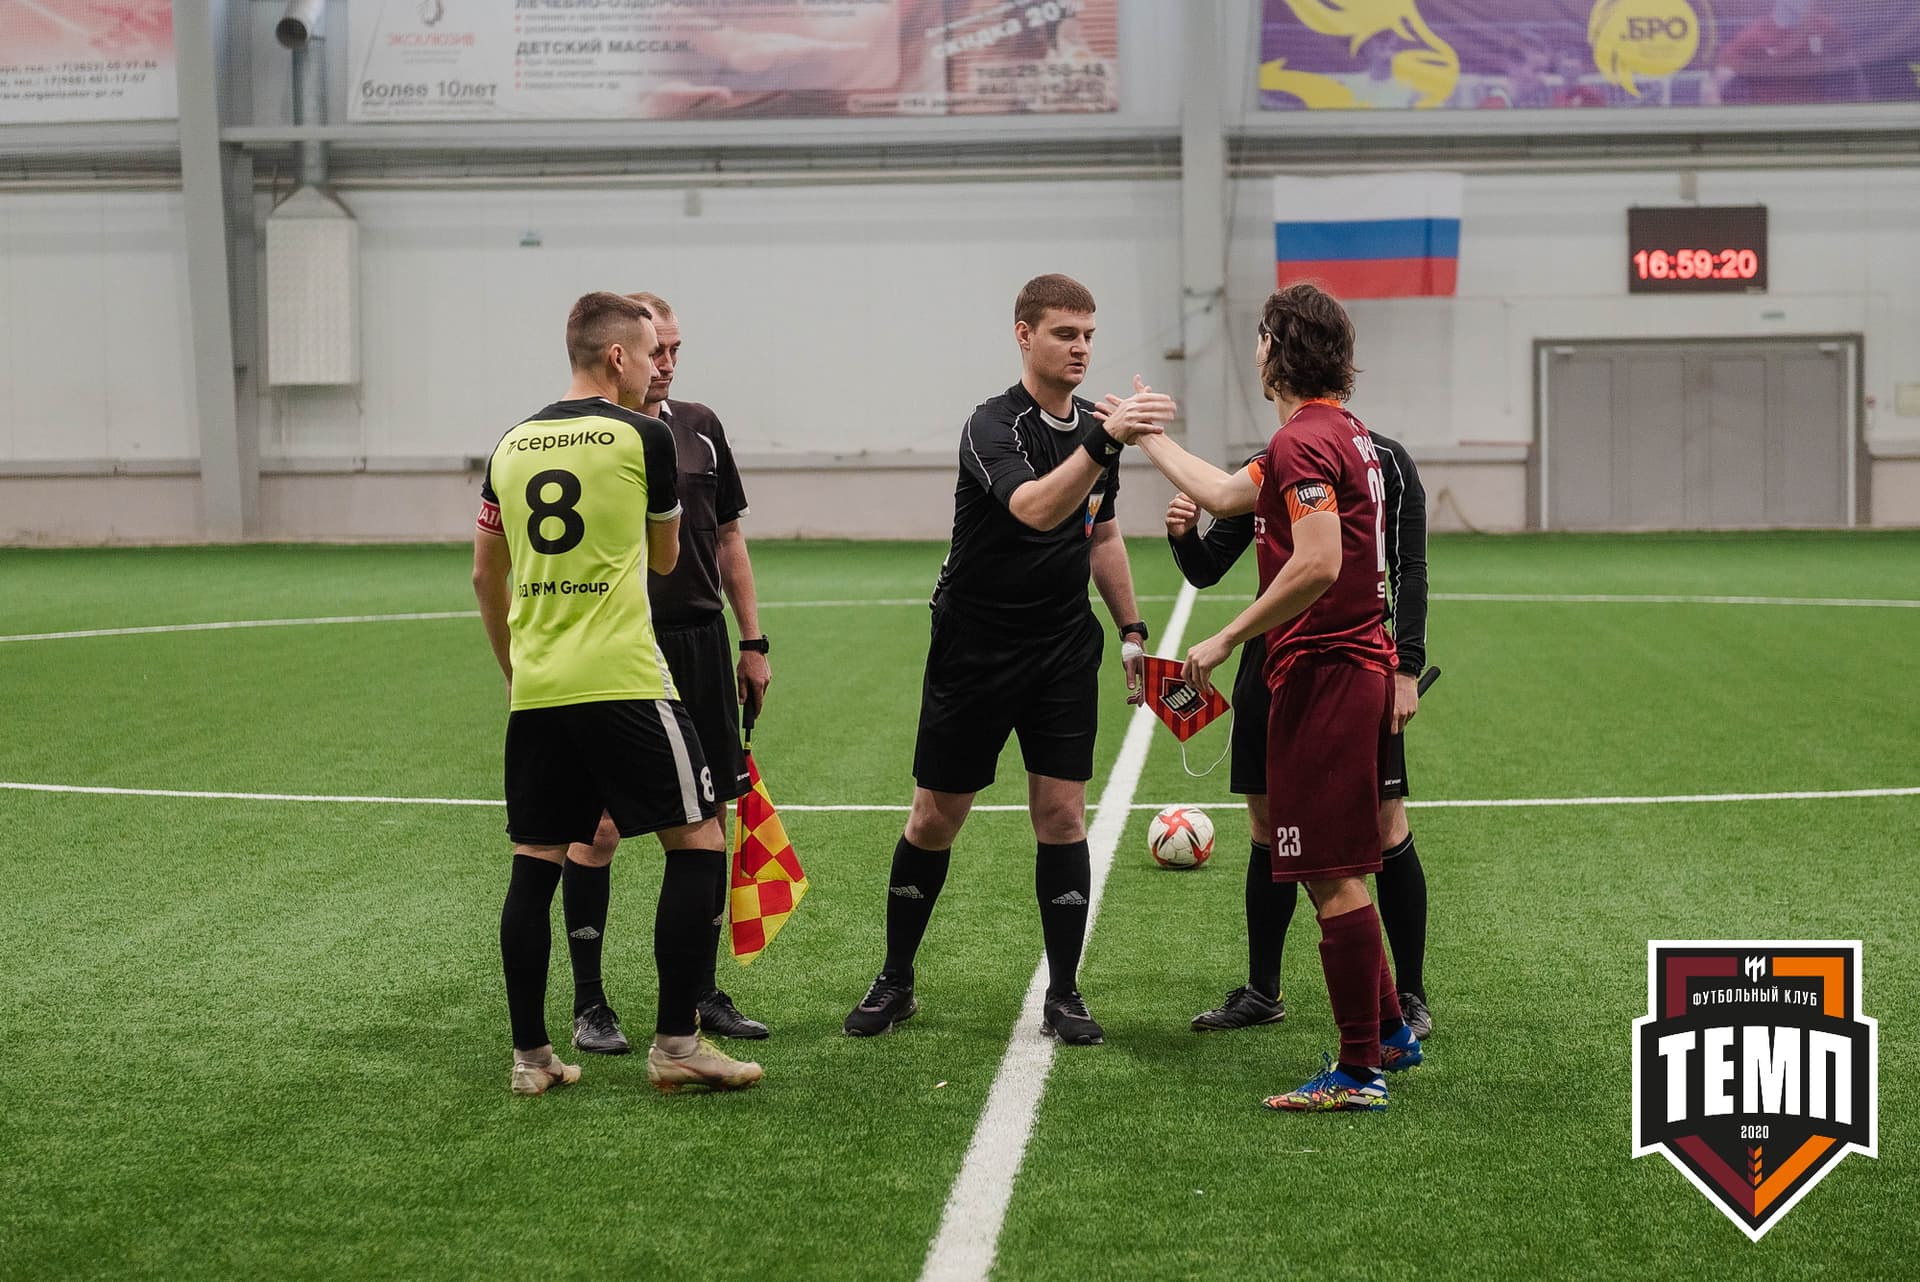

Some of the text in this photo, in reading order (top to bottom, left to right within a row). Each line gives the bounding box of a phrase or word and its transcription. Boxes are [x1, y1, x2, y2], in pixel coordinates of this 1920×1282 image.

[1619, 16, 1689, 40] .БРО
[516, 38, 602, 56] ДЕТСКИЙ
[362, 79, 497, 98] более 10лет
[1634, 249, 1758, 279] 16:59:20
[517, 431, 615, 451] сервико
[1298, 486, 1326, 502] ТЕМП
[525, 469, 585, 555] 8
[560, 580, 610, 595] Group
[700, 766, 715, 802] 8
[1277, 826, 1302, 857] 23
